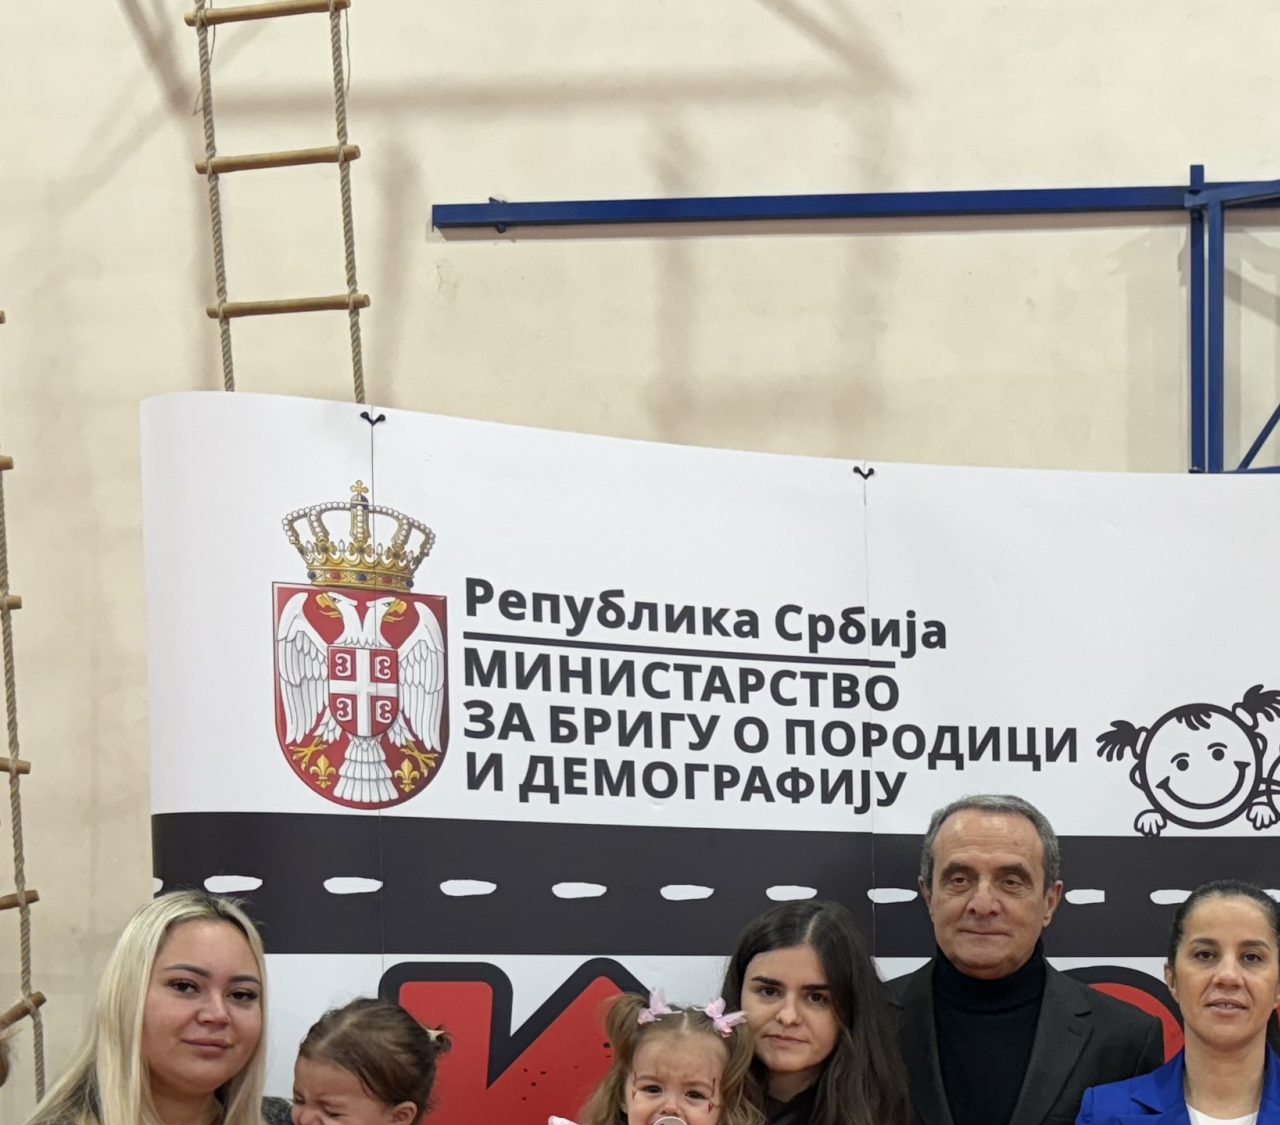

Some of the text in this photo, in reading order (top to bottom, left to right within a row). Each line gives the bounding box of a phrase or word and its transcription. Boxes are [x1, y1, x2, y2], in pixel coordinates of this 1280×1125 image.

[465, 578, 949, 659] Република Србија
[464, 648, 899, 711] МИНИСТАРСТВО
[463, 700, 1077, 772] ЗА БРИГУ О ПОРОДИЦИ
[466, 752, 907, 815] И ДЕМОГРАФИЈУ
